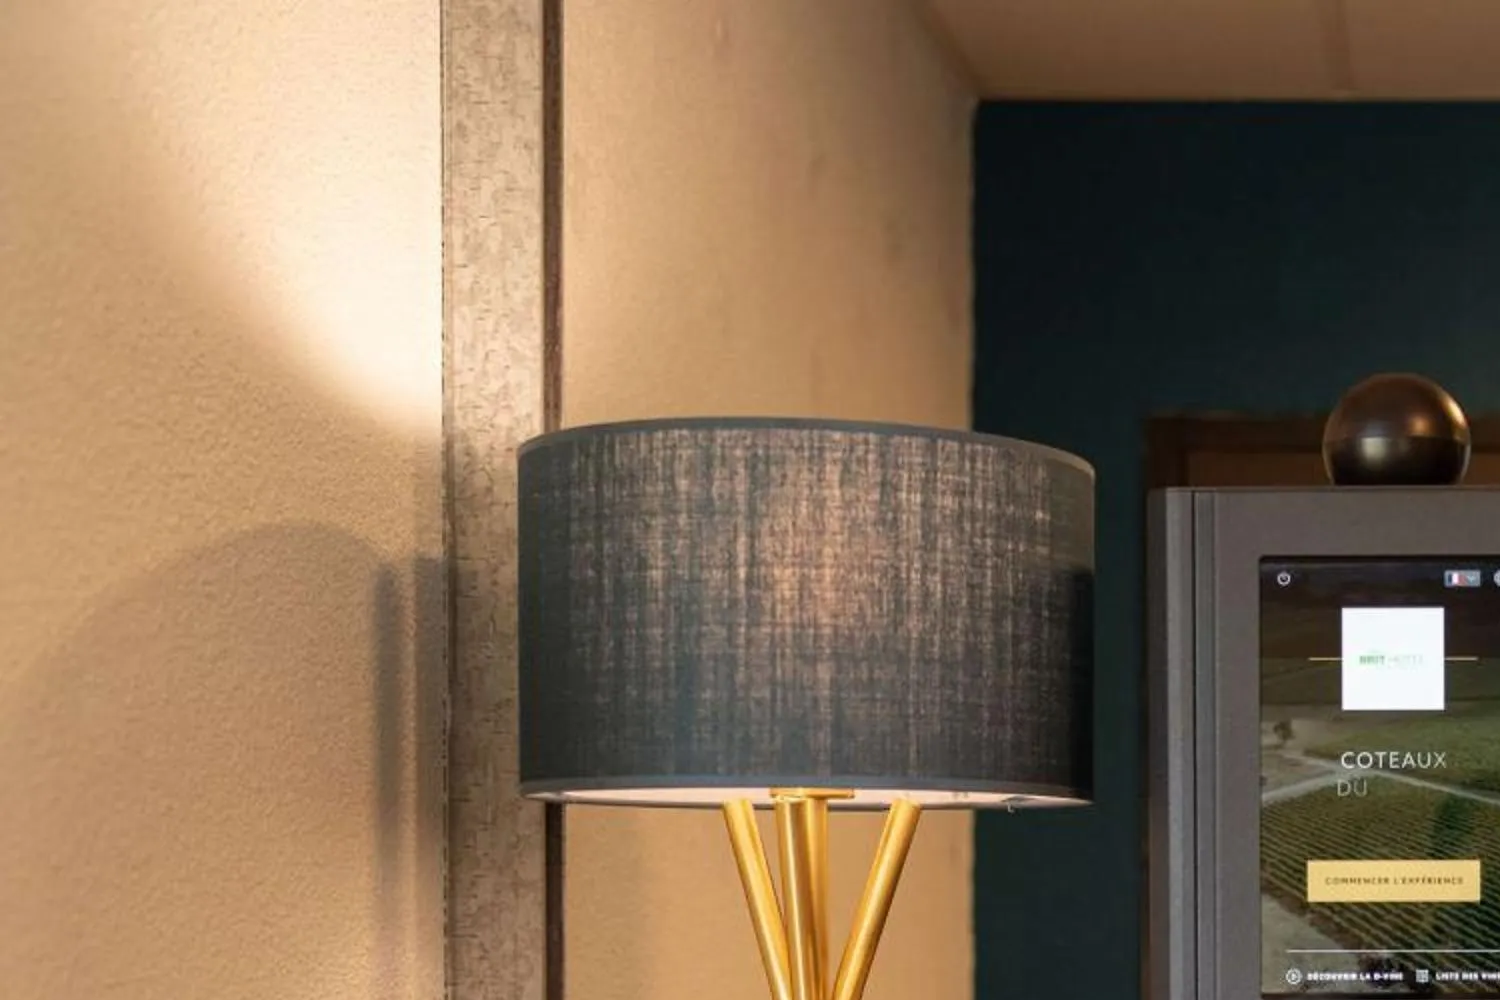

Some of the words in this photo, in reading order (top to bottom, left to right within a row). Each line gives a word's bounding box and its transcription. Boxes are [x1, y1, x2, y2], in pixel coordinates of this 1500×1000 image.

[1340, 751, 1448, 769] COTEAUX
[1336, 779, 1369, 797] DU
[1324, 876, 1390, 886] COMMENCER
[1359, 971, 1372, 981] LA
